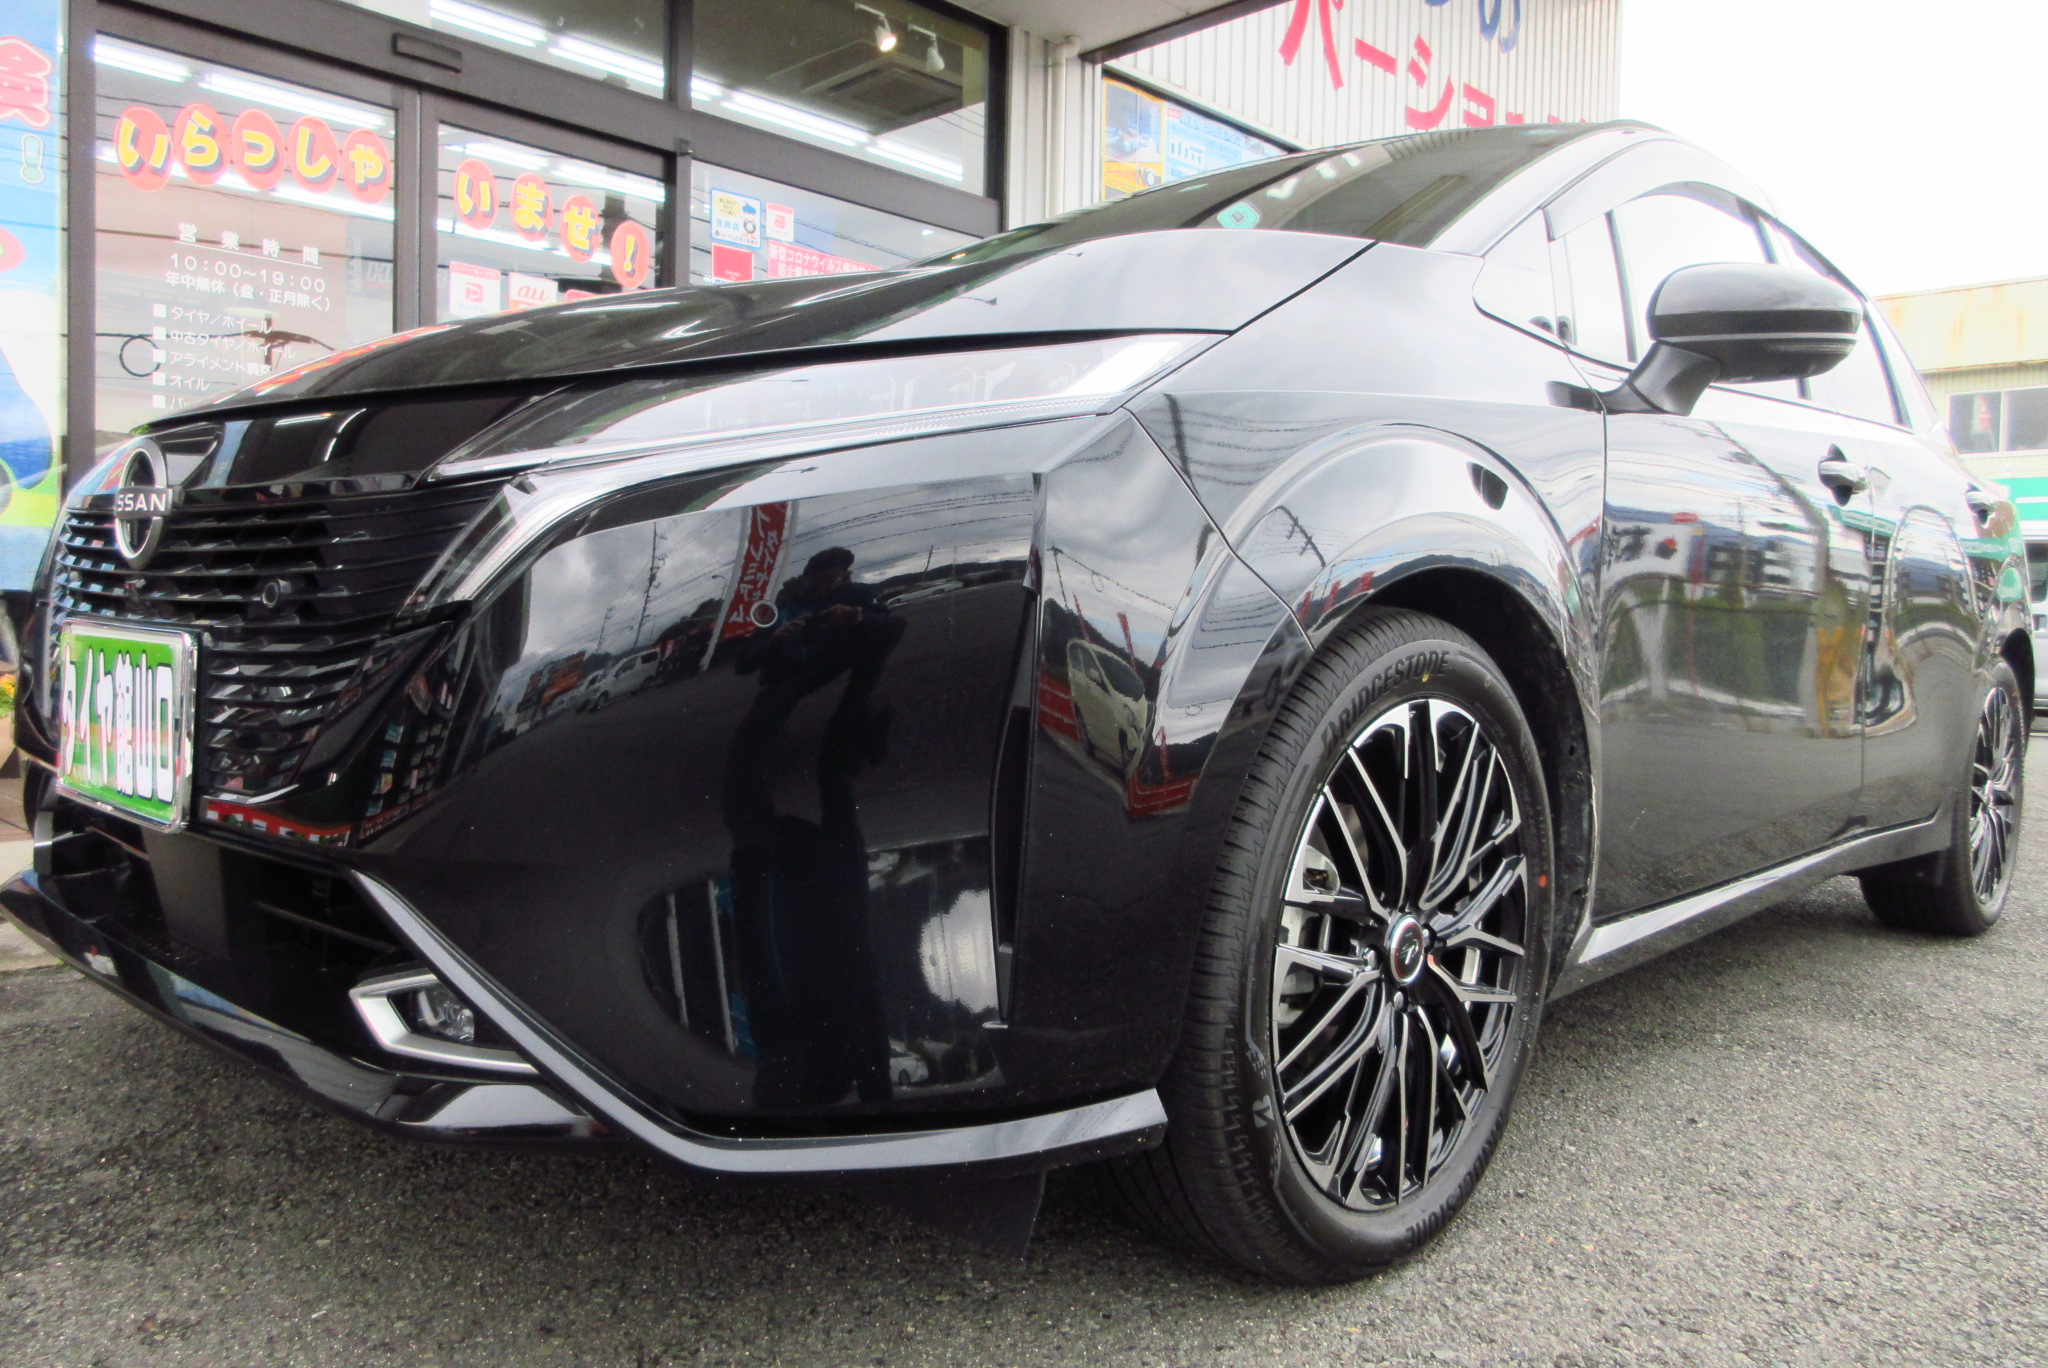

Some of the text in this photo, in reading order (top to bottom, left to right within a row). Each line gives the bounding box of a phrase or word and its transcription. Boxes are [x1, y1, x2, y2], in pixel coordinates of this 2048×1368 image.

[117, 109, 385, 184] いらっしゃ
[178, 222, 319, 265] 営業時間
[517, 285, 551, 303] au
[170, 374, 210, 391] オイル
[61, 644, 173, 805] タイヤ館山口
[1321, 650, 1450, 760] BRIDGESTONE
